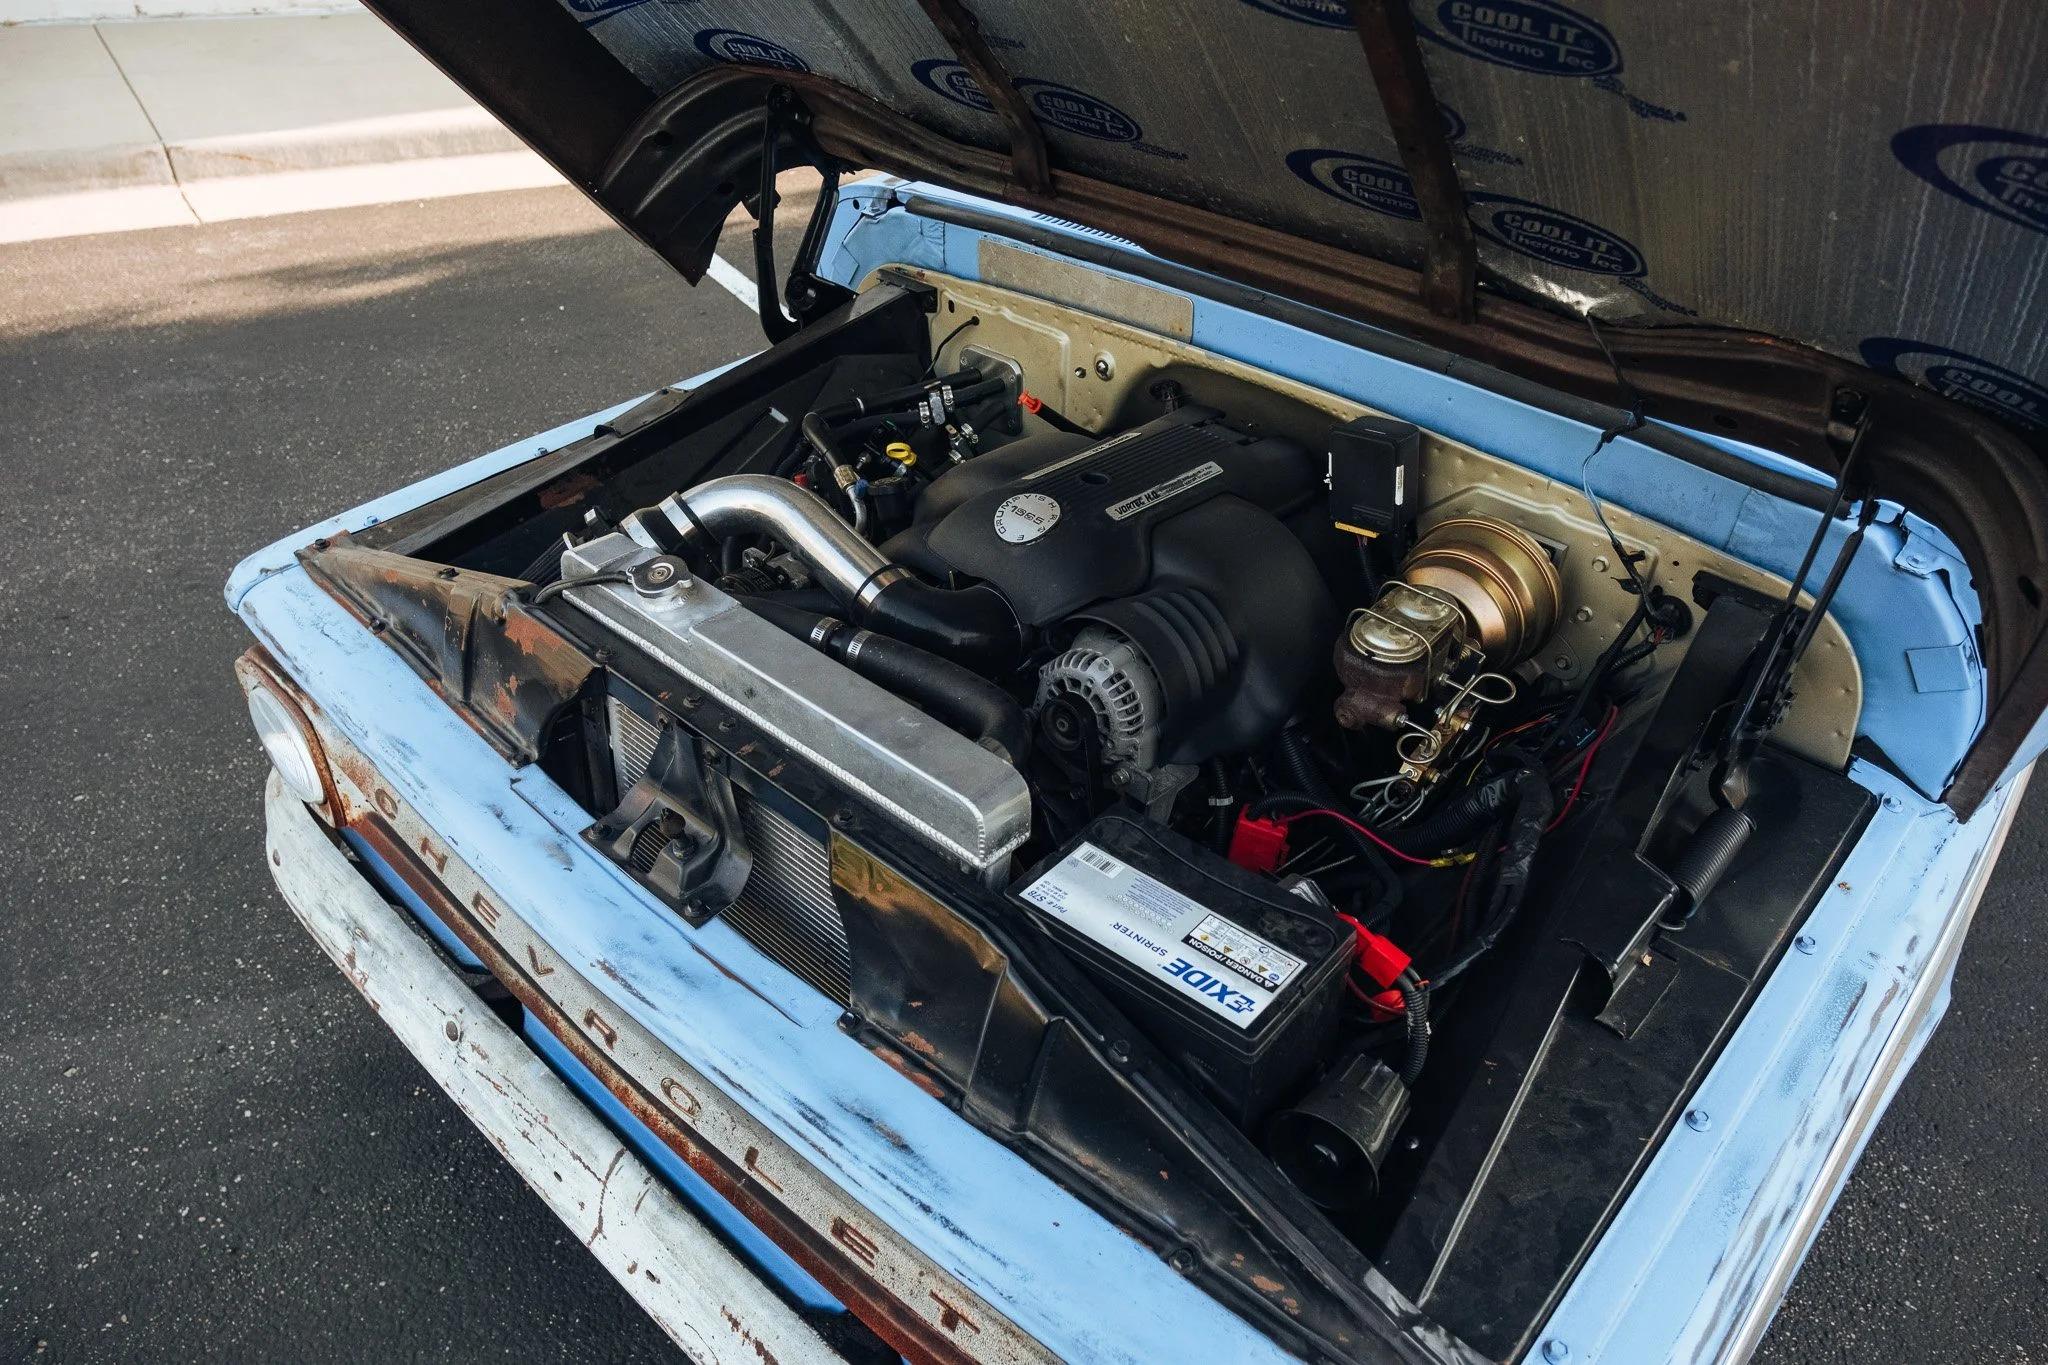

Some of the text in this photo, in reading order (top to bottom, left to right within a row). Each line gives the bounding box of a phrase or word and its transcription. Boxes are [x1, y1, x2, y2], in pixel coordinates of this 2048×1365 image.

[1452, 2, 1583, 44] COOL IT
[727, 42, 768, 57] COOL
[1456, 20, 1596, 69] Thermo Tec
[1040, 95, 1112, 121] COOL IT
[1046, 107, 1100, 130] Thermo
[1342, 168, 1408, 196] COOL
[1503, 213, 1614, 252] COOL IT
[1509, 229, 1624, 272] Thermo Tec
[1943, 368, 2040, 417] COOL
[1011, 505, 1045, 525] 1965
[1114, 496, 1144, 515] VORTEC
[1027, 890, 1046, 902] S78
[1113, 922, 1168, 957] SPRINTER
[1162, 958, 1256, 1014] EXIDE
[1230, 959, 1266, 984] DANGER
[375, 788, 980, 1334] CHEVROLET
